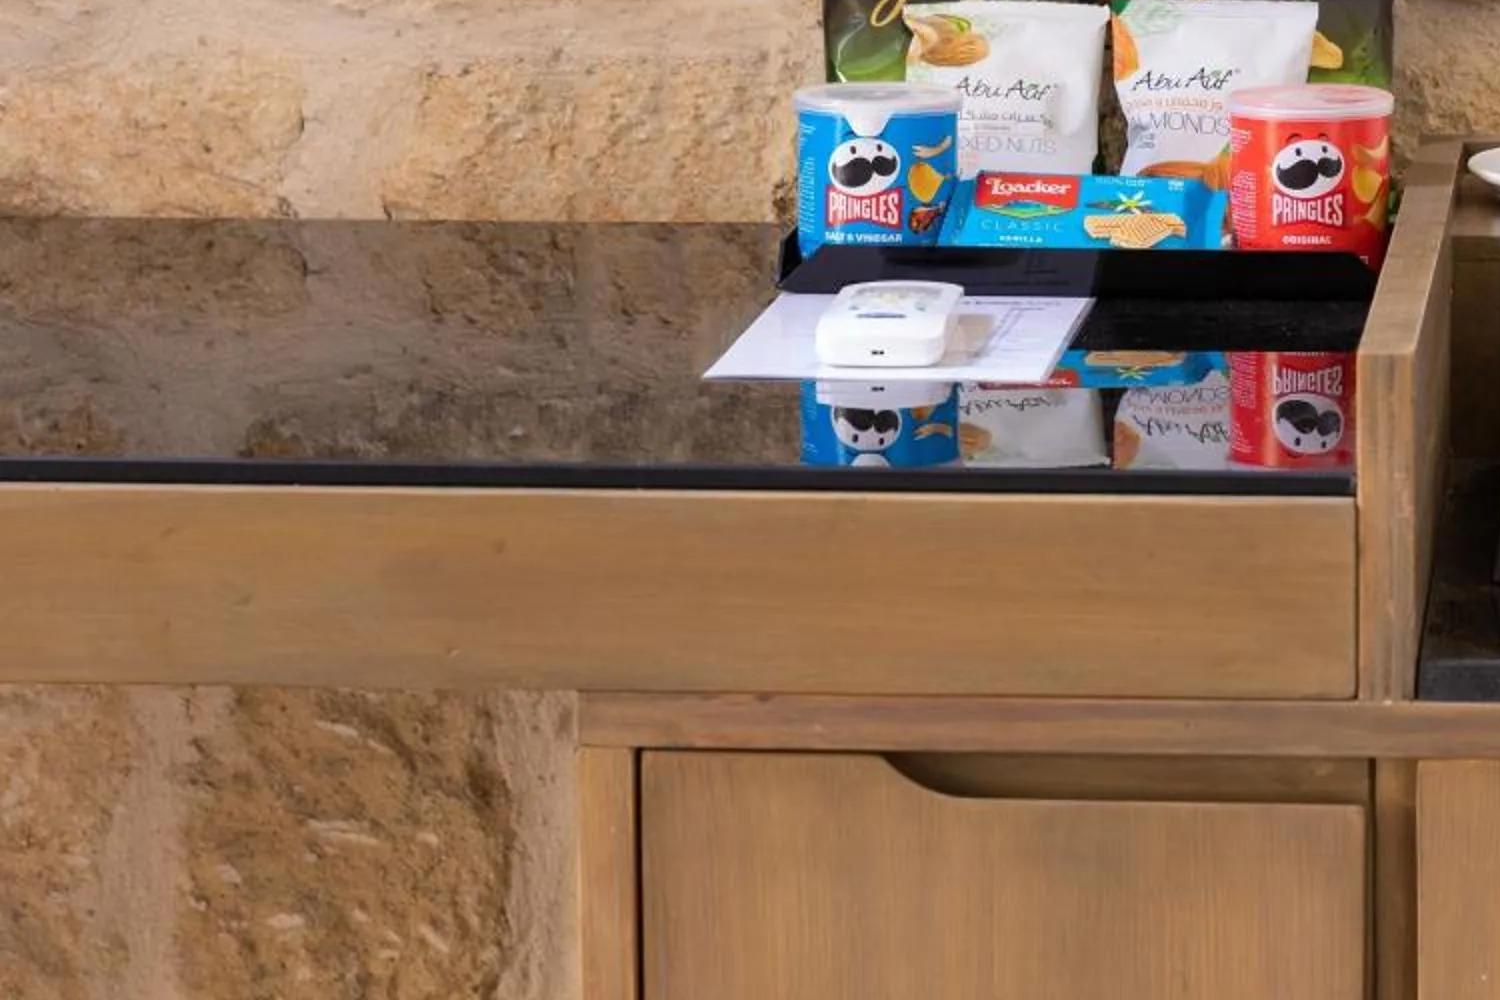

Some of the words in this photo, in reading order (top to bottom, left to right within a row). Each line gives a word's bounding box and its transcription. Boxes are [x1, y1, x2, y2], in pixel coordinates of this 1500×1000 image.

[958, 134, 1002, 153] XED
[985, 177, 1073, 196] Loacker
[827, 190, 900, 228] PRINGLES
[1271, 192, 1344, 228] PRINGLES
[980, 218, 1064, 233] CLASSIC
